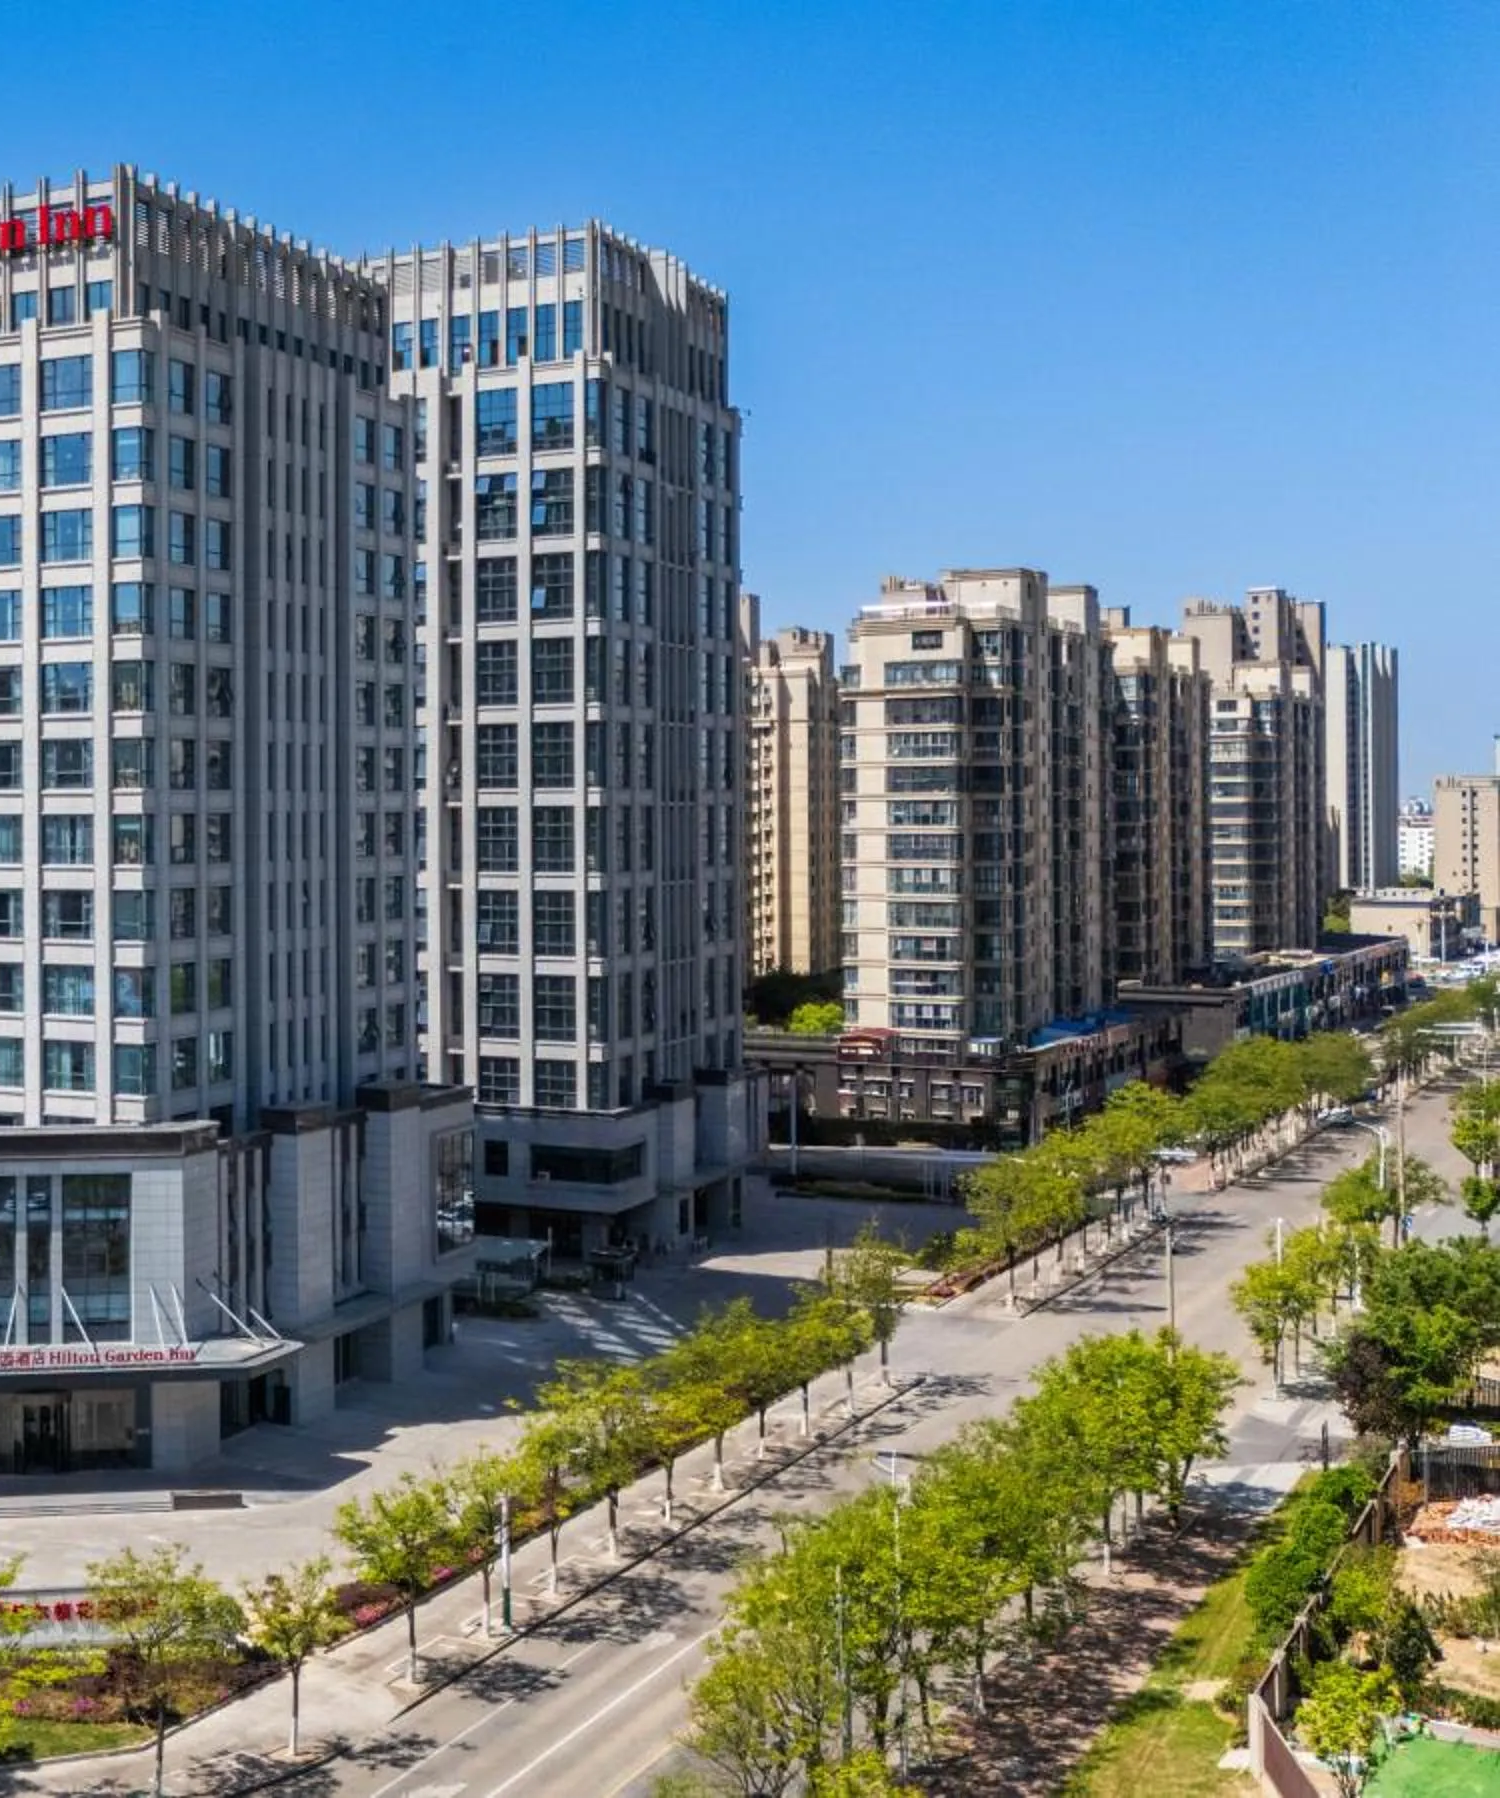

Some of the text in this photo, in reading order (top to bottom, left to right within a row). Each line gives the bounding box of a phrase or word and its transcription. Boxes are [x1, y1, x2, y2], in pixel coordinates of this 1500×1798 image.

[37, 204, 114, 245] Inn
[49, 1350, 100, 1364] Hilton
[105, 1349, 163, 1362] Garden
